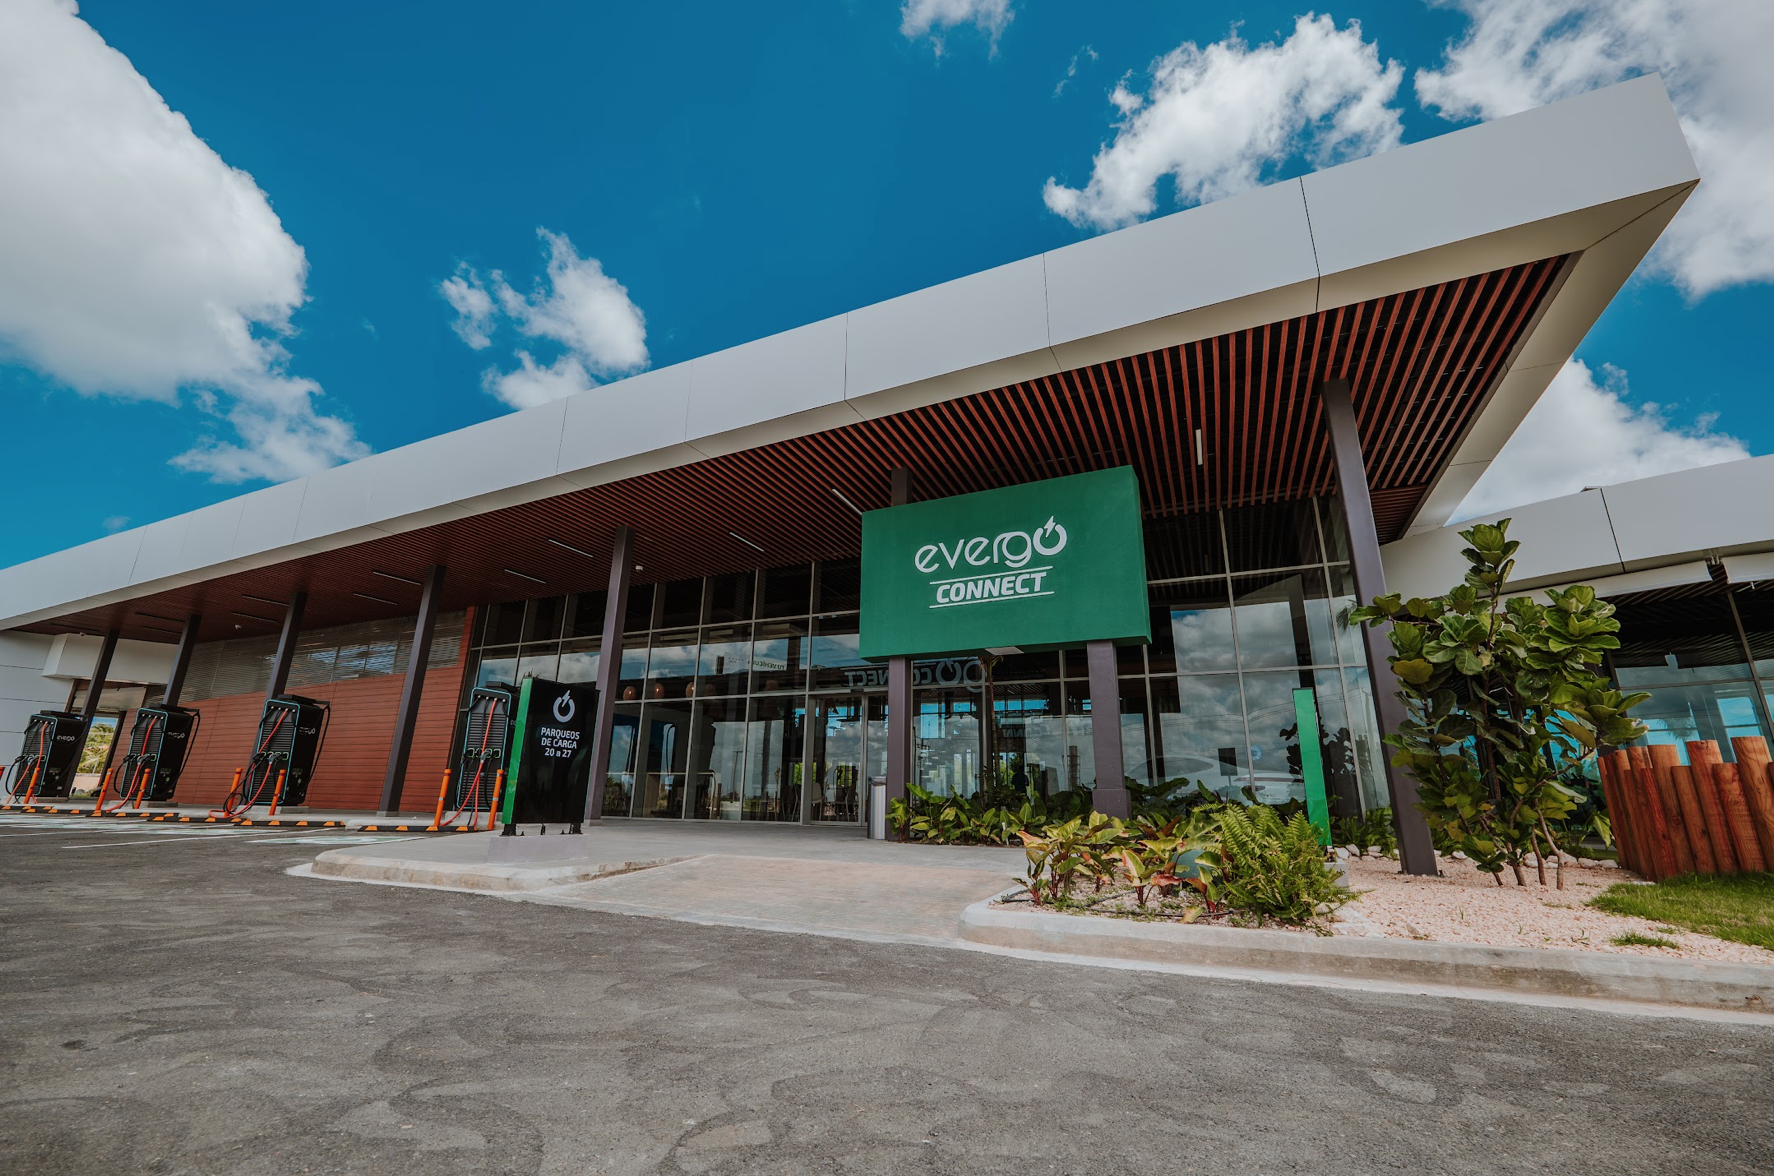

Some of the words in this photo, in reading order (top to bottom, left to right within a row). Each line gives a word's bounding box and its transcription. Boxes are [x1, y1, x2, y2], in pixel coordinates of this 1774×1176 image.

[915, 516, 1067, 573] evergo
[936, 571, 1047, 604] CONNECT
[541, 727, 580, 740] PARQUEOS
[541, 737, 552, 746] DE
[553, 738, 577, 749] CARGA
[544, 747, 555, 757] 20
[562, 749, 572, 758] 27
